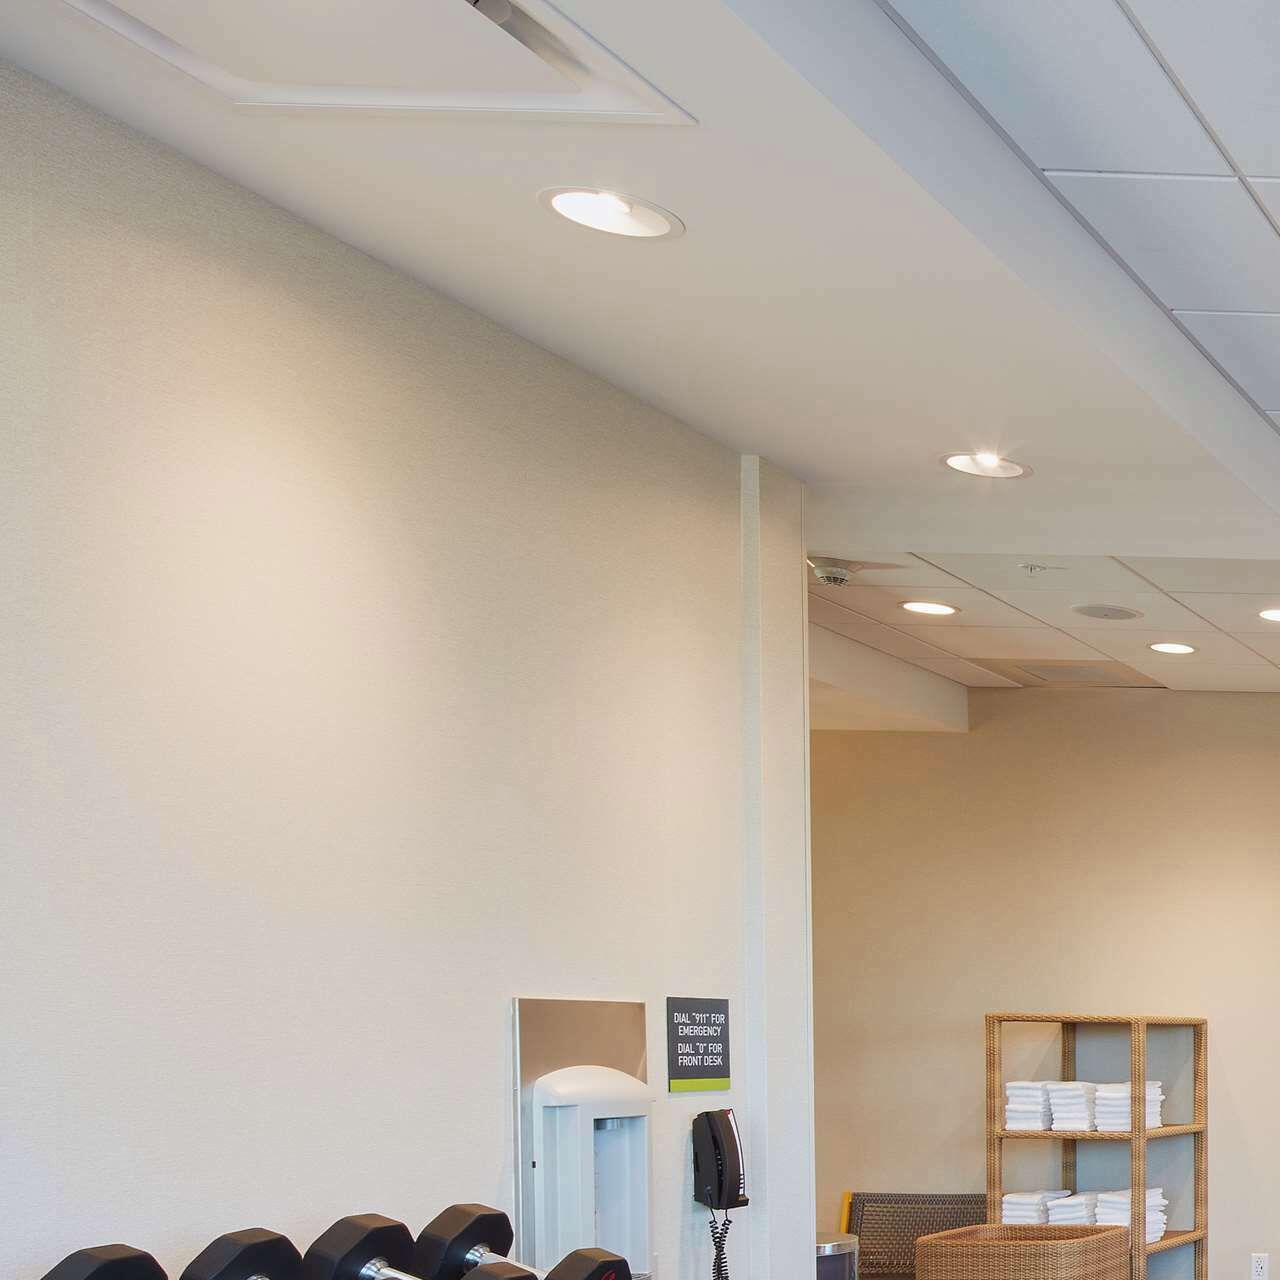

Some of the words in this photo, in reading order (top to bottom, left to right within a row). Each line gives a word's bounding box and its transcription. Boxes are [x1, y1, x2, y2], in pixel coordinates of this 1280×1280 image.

[673, 1012, 691, 1024] DIAL
[692, 1013, 709, 1024] "911"
[711, 1014, 725, 1024] FOR
[678, 1026, 722, 1036] EMERGENCY
[678, 1043, 695, 1054] DIAL
[708, 1043, 723, 1054] FOR
[678, 1055, 702, 1066] FRONT
[704, 1055, 723, 1066] DESK
